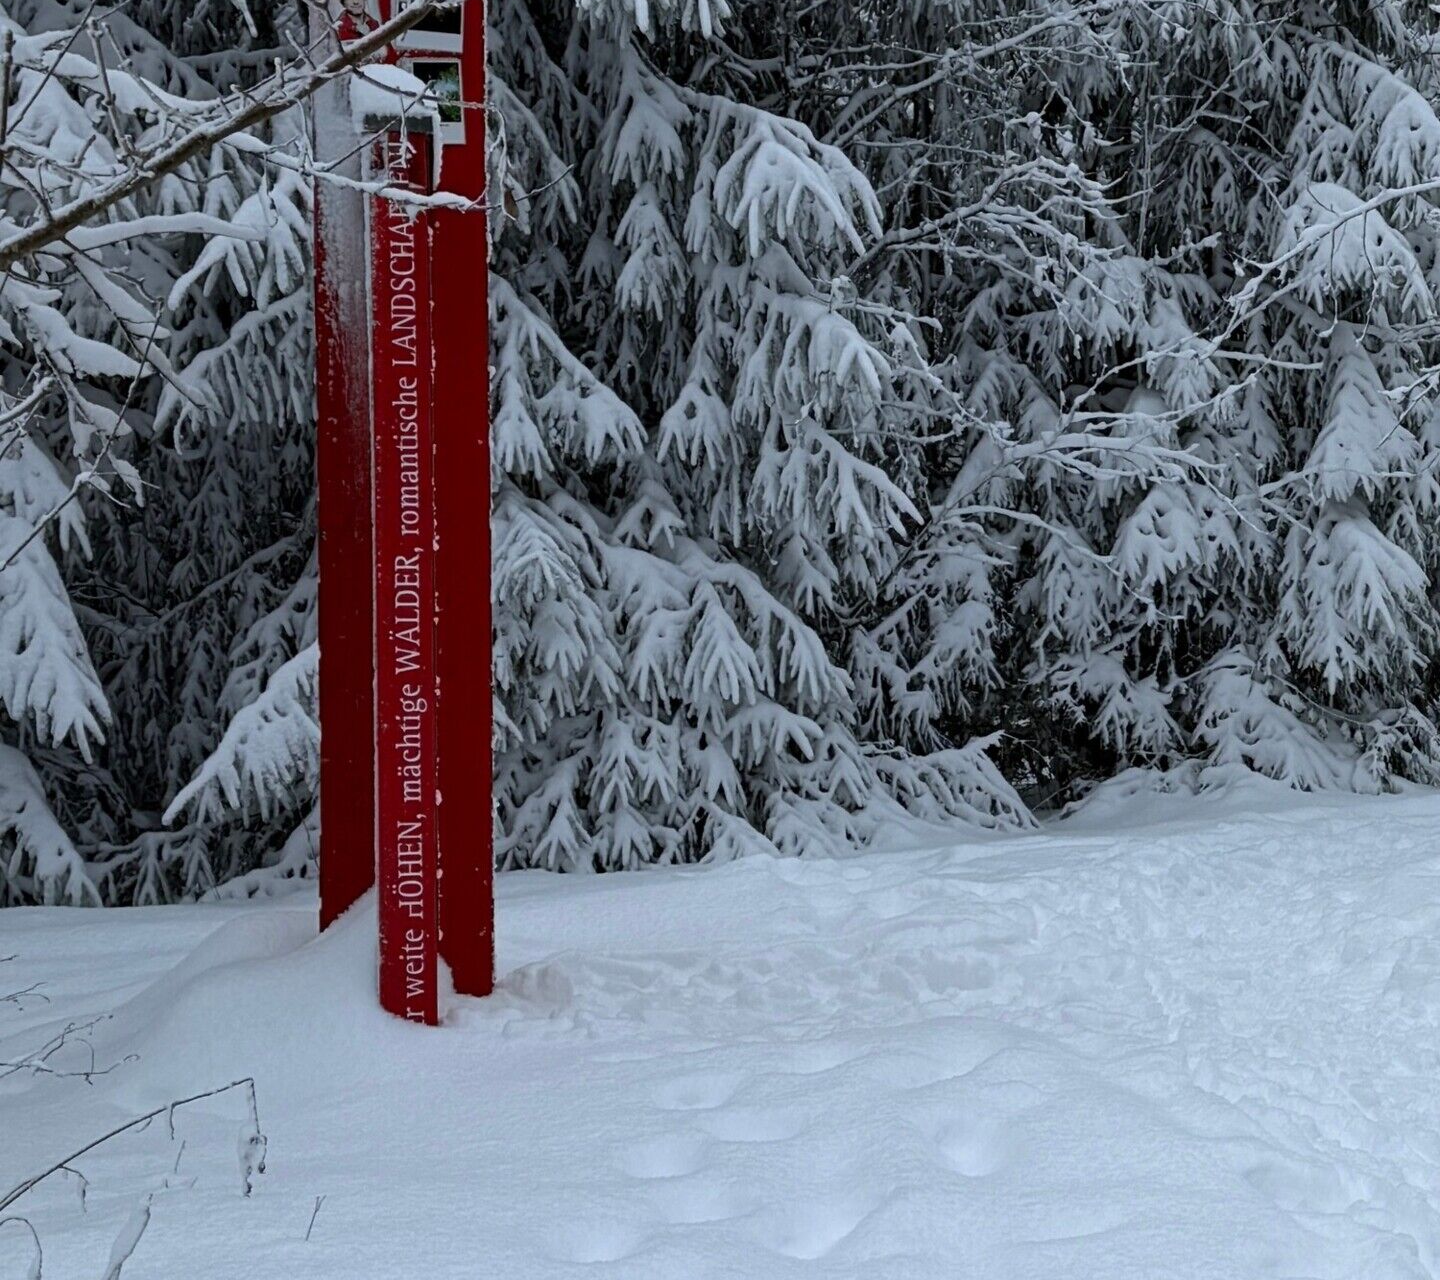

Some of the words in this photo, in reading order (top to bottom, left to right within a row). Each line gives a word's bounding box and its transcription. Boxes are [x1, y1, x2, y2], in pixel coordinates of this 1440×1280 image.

[391, 376, 420, 537] romantische
[388, 545, 425, 675] WÄLDER,
[395, 683, 428, 803] mächtige
[391, 813, 427, 919] HÖHEN,
[398, 928, 425, 999] weite
